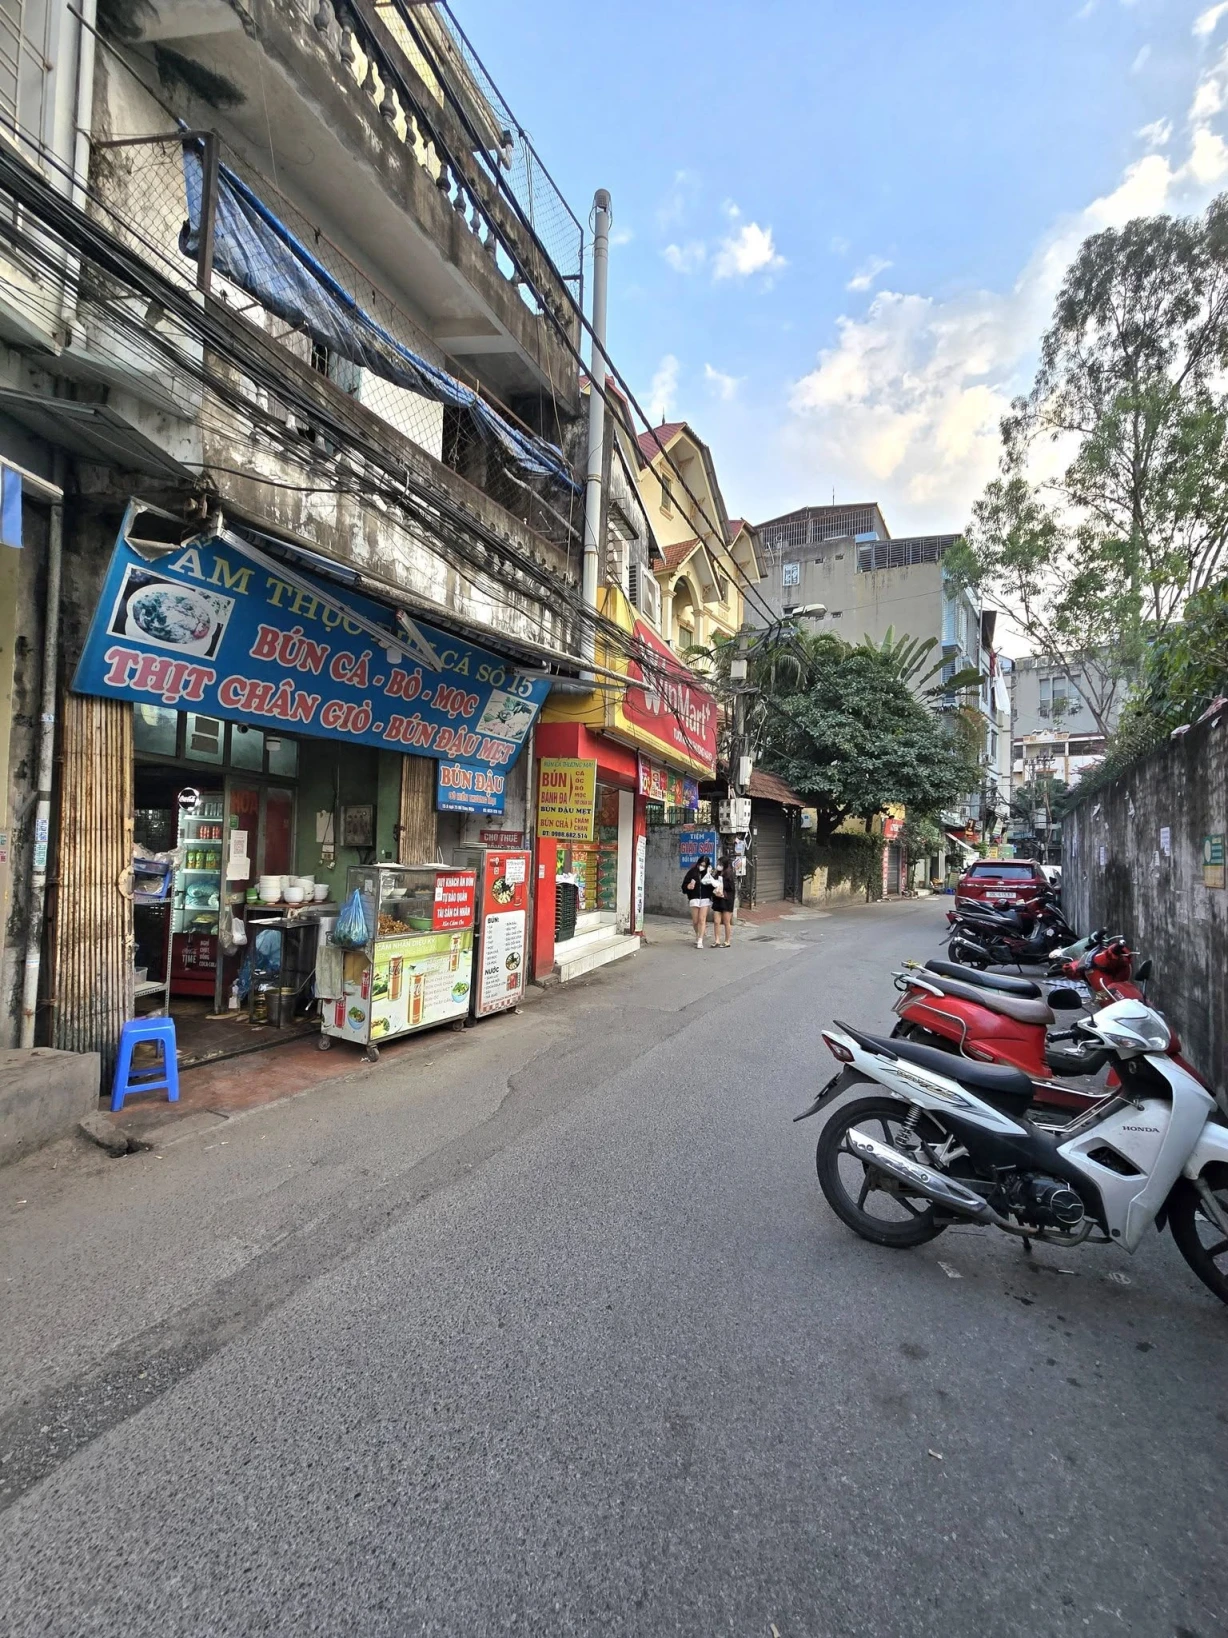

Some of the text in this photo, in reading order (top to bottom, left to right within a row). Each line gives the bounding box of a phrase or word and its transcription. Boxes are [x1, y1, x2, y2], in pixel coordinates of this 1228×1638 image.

[250, 623, 330, 675] BÚN
[330, 650, 372, 688] CÁ
[384, 668, 422, 700] BÒ
[431, 684, 480, 719] MỌC
[441, 651, 472, 676] CÁ
[507, 673, 533, 697] 15
[104, 645, 216, 704] THỊT
[217, 678, 321, 723] CHÂN
[320, 699, 372, 734] GIÒ
[383, 713, 439, 749] BÚN
[433, 725, 481, 758] ĐẬU
[476, 738, 515, 766] MẸT
[440, 763, 504, 797] BÚN ĐẬU
[542, 769, 567, 787] BÚN
[541, 789, 558, 804] BÁNH
[558, 806, 574, 814] ĐẬU
[540, 817, 568, 828] BÚN CHẢ
[484, 833, 518, 843] CHO THUÊ
[485, 966, 499, 975] NƯỚC
